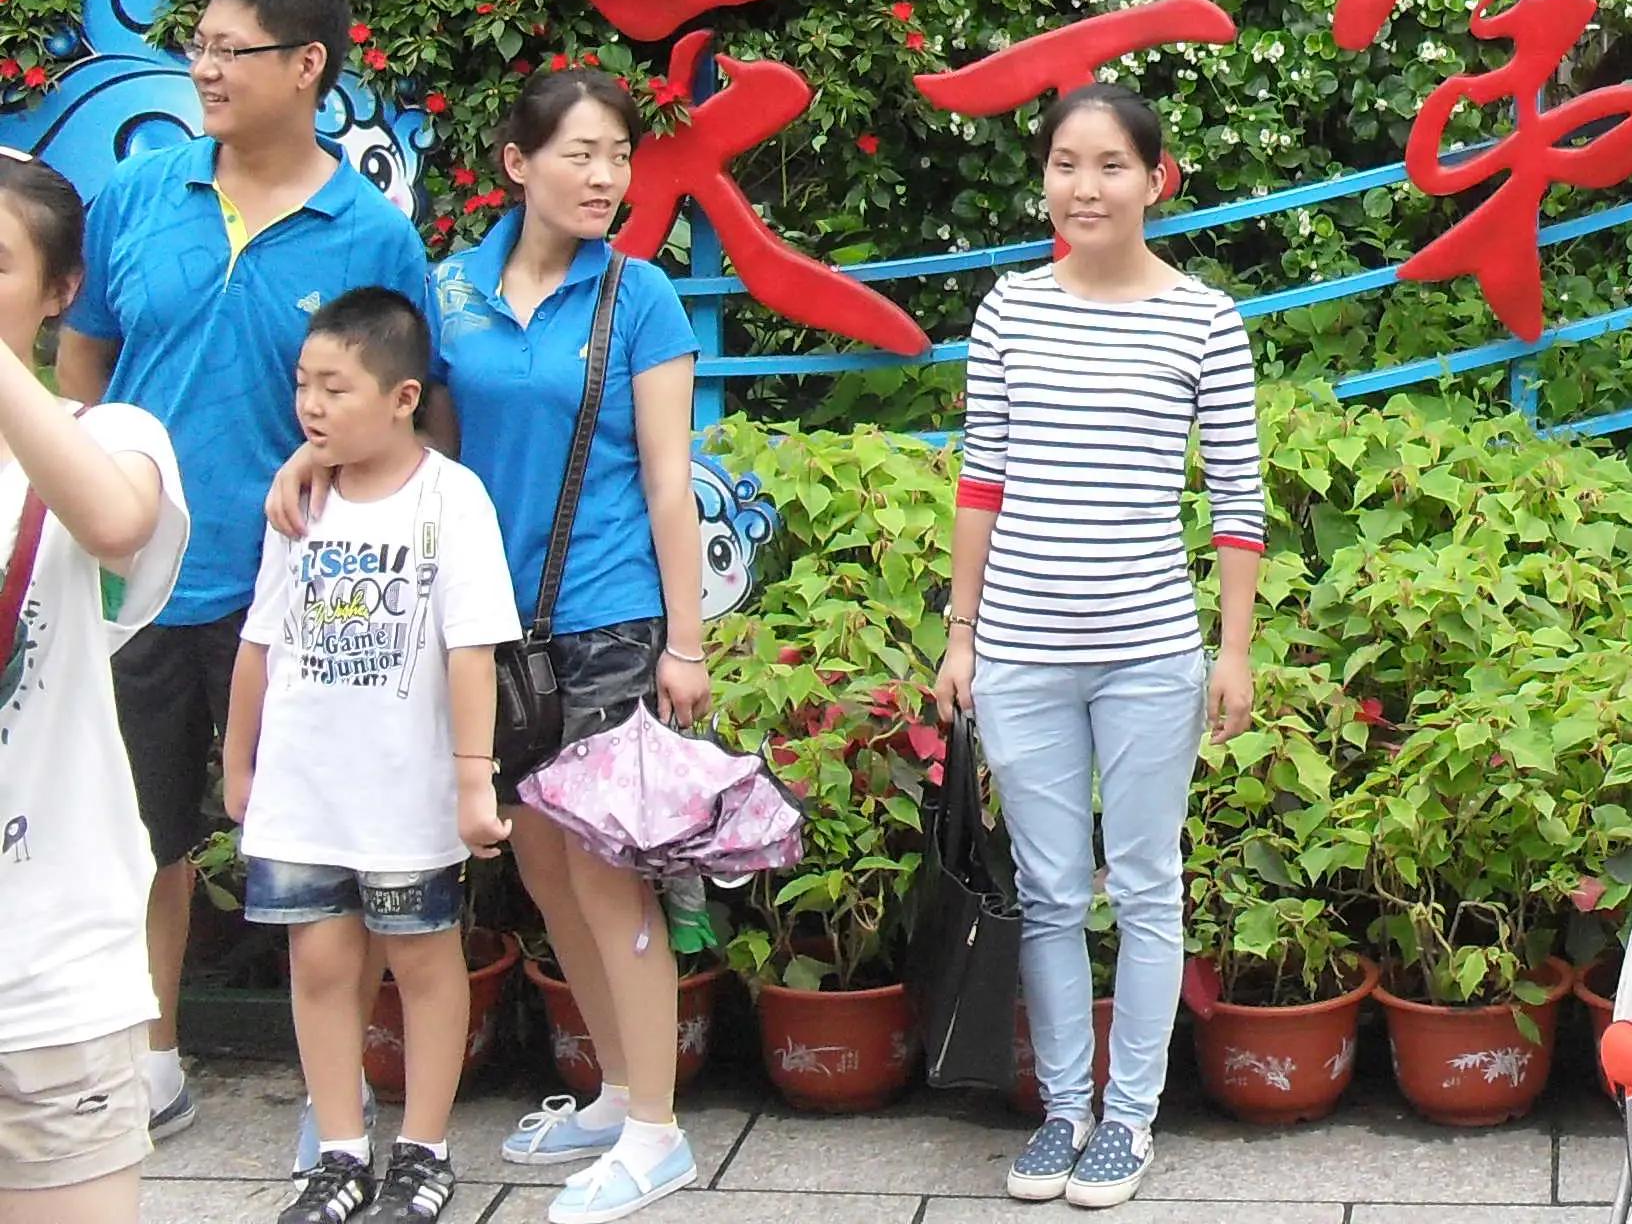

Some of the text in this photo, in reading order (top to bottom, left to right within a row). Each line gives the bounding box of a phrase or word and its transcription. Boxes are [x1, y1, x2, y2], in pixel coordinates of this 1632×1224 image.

[319, 548, 378, 578] See
[325, 630, 387, 655] Game
[321, 651, 402, 684] Junior
